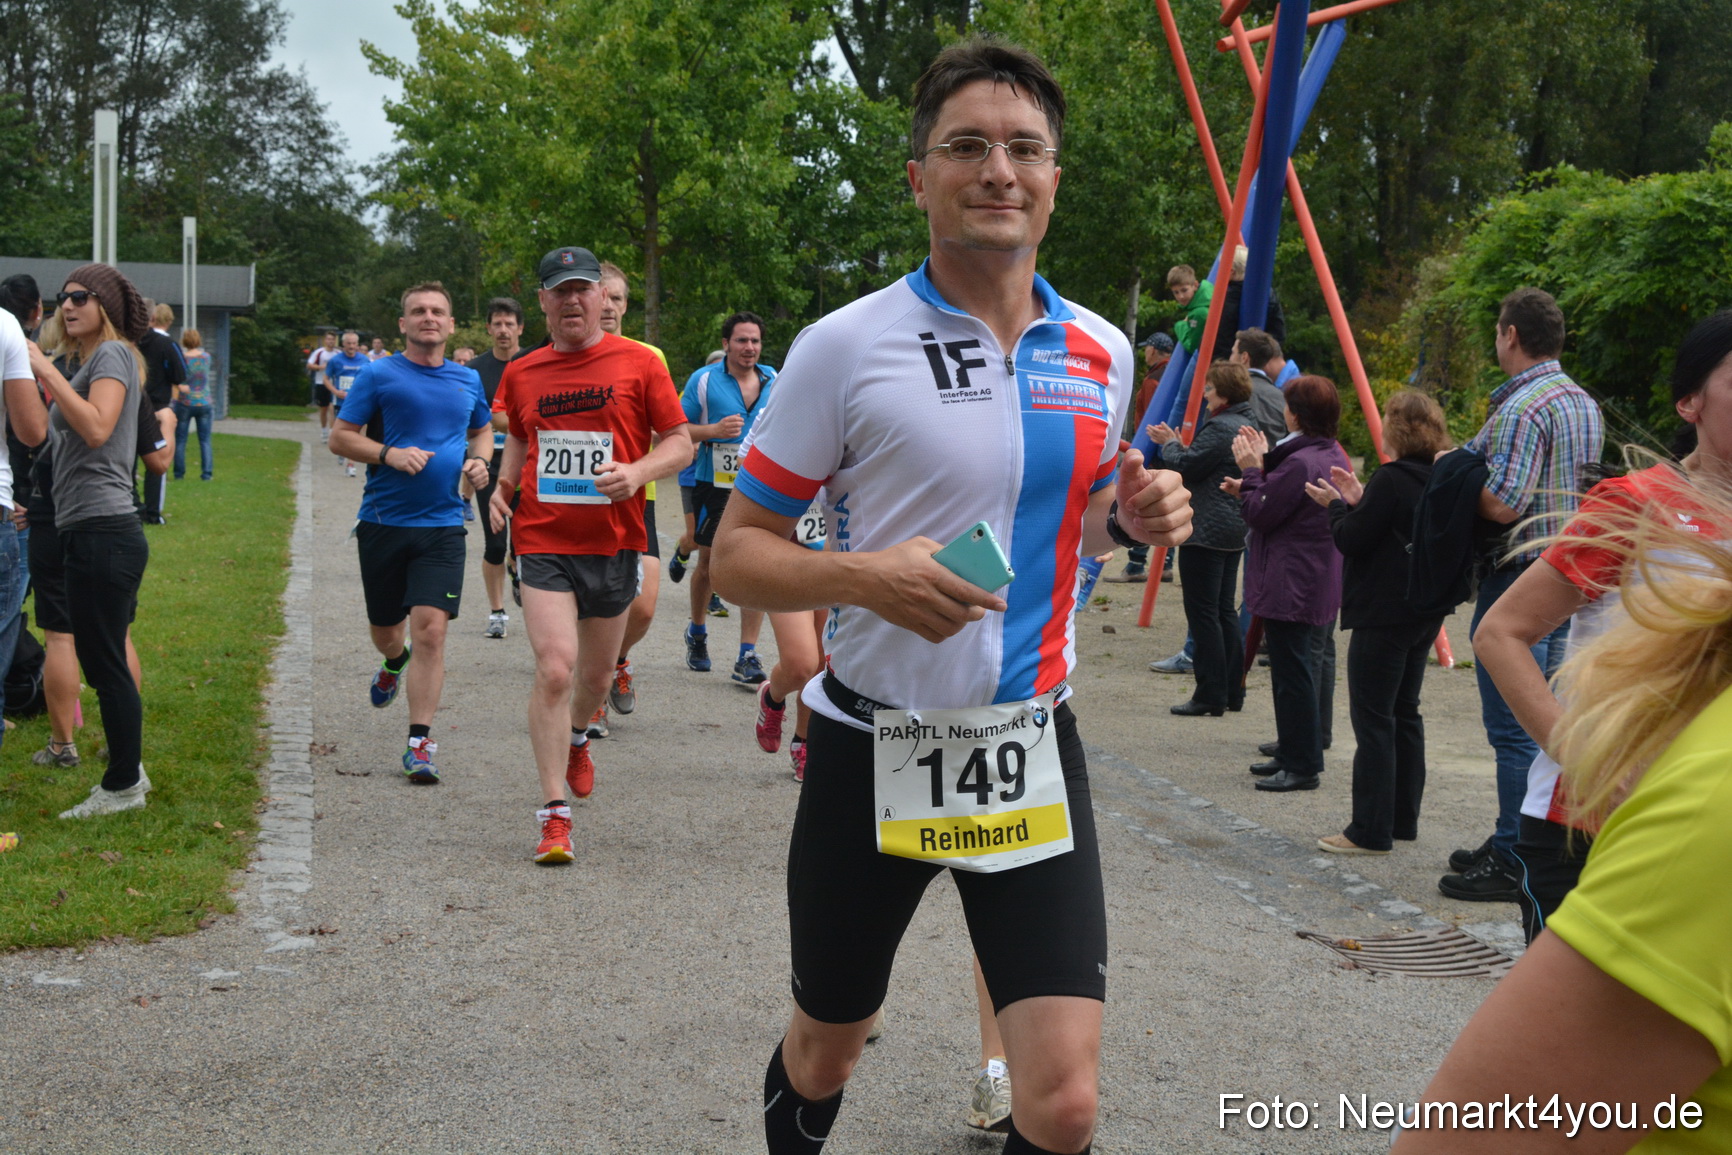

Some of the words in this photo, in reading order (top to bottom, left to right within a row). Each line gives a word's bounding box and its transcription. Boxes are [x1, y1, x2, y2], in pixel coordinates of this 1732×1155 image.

[939, 390, 978, 399] InterFace
[980, 388, 992, 396] AG
[1028, 380, 1046, 395] LA
[1049, 382, 1102, 402] CARRERA
[541, 404, 559, 415] RUN
[560, 400, 576, 413] FOR
[1031, 395, 1070, 406] TRITEAM
[539, 437, 561, 445] PARTL
[562, 438, 599, 446] Neumarkt
[543, 448, 605, 476] 2018
[554, 481, 589, 494] Günter
[879, 725, 943, 741] PARTL
[948, 714, 1027, 740] Neumarkt
[916, 740, 1027, 808] 149
[883, 808, 892, 819] A
[920, 818, 1030, 852] Reinhard
